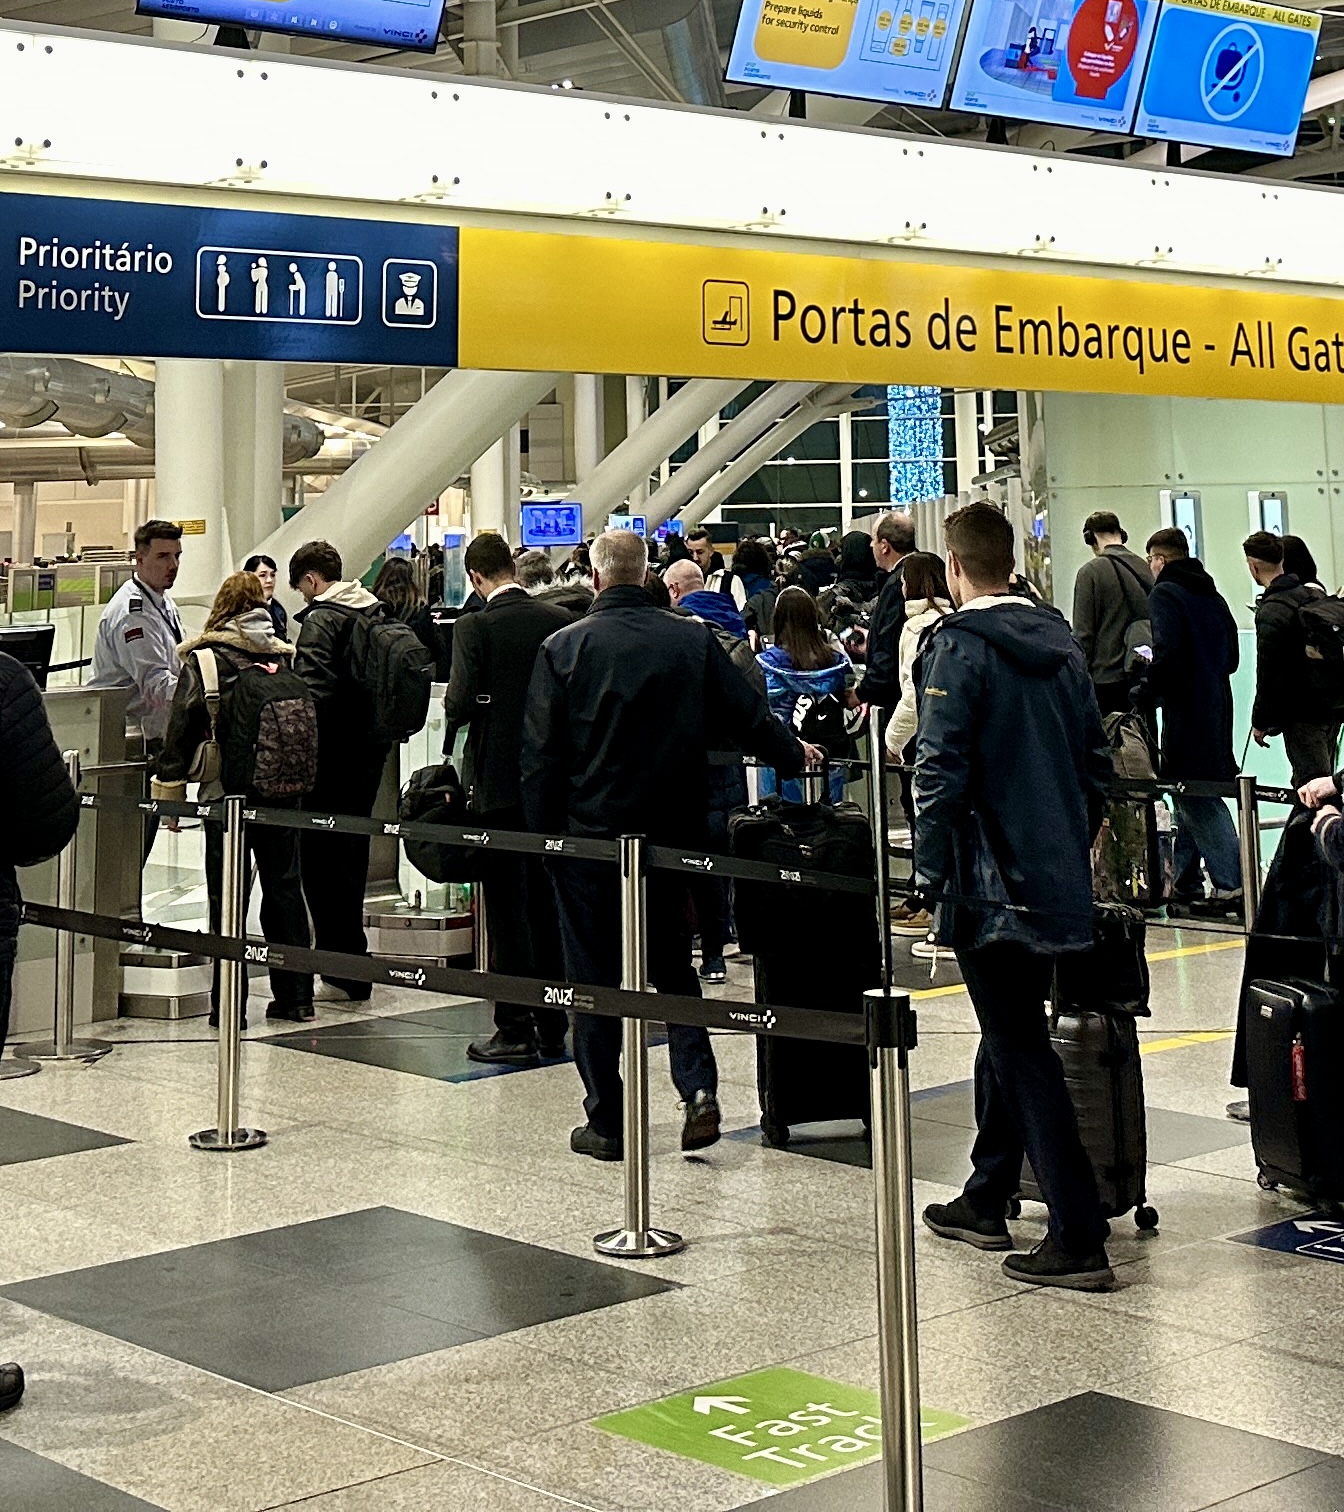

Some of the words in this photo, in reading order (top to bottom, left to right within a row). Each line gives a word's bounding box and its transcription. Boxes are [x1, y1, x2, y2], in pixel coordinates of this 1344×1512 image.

[761, 14, 774, 26] for
[776, 17, 809, 33] security
[809, 23, 839, 35] control
[764, 0, 797, 16] Prepare
[798, 5, 823, 19] liquids
[1222, 0, 1266, 19] EMBARQUE
[1272, 10, 1286, 23] ALL
[1287, 13, 1312, 28] GATES
[19, 236, 173, 274] Prioritário
[18, 279, 130, 321] Priority
[772, 289, 912, 349] Portas
[927, 297, 977, 352] de
[994, 304, 1191, 375] Embarque
[1229, 320, 1275, 369] All
[728, 1011, 761, 1023] VINCI
[708, 1401, 859, 1447] Fast
[742, 1415, 938, 1469] Trac
